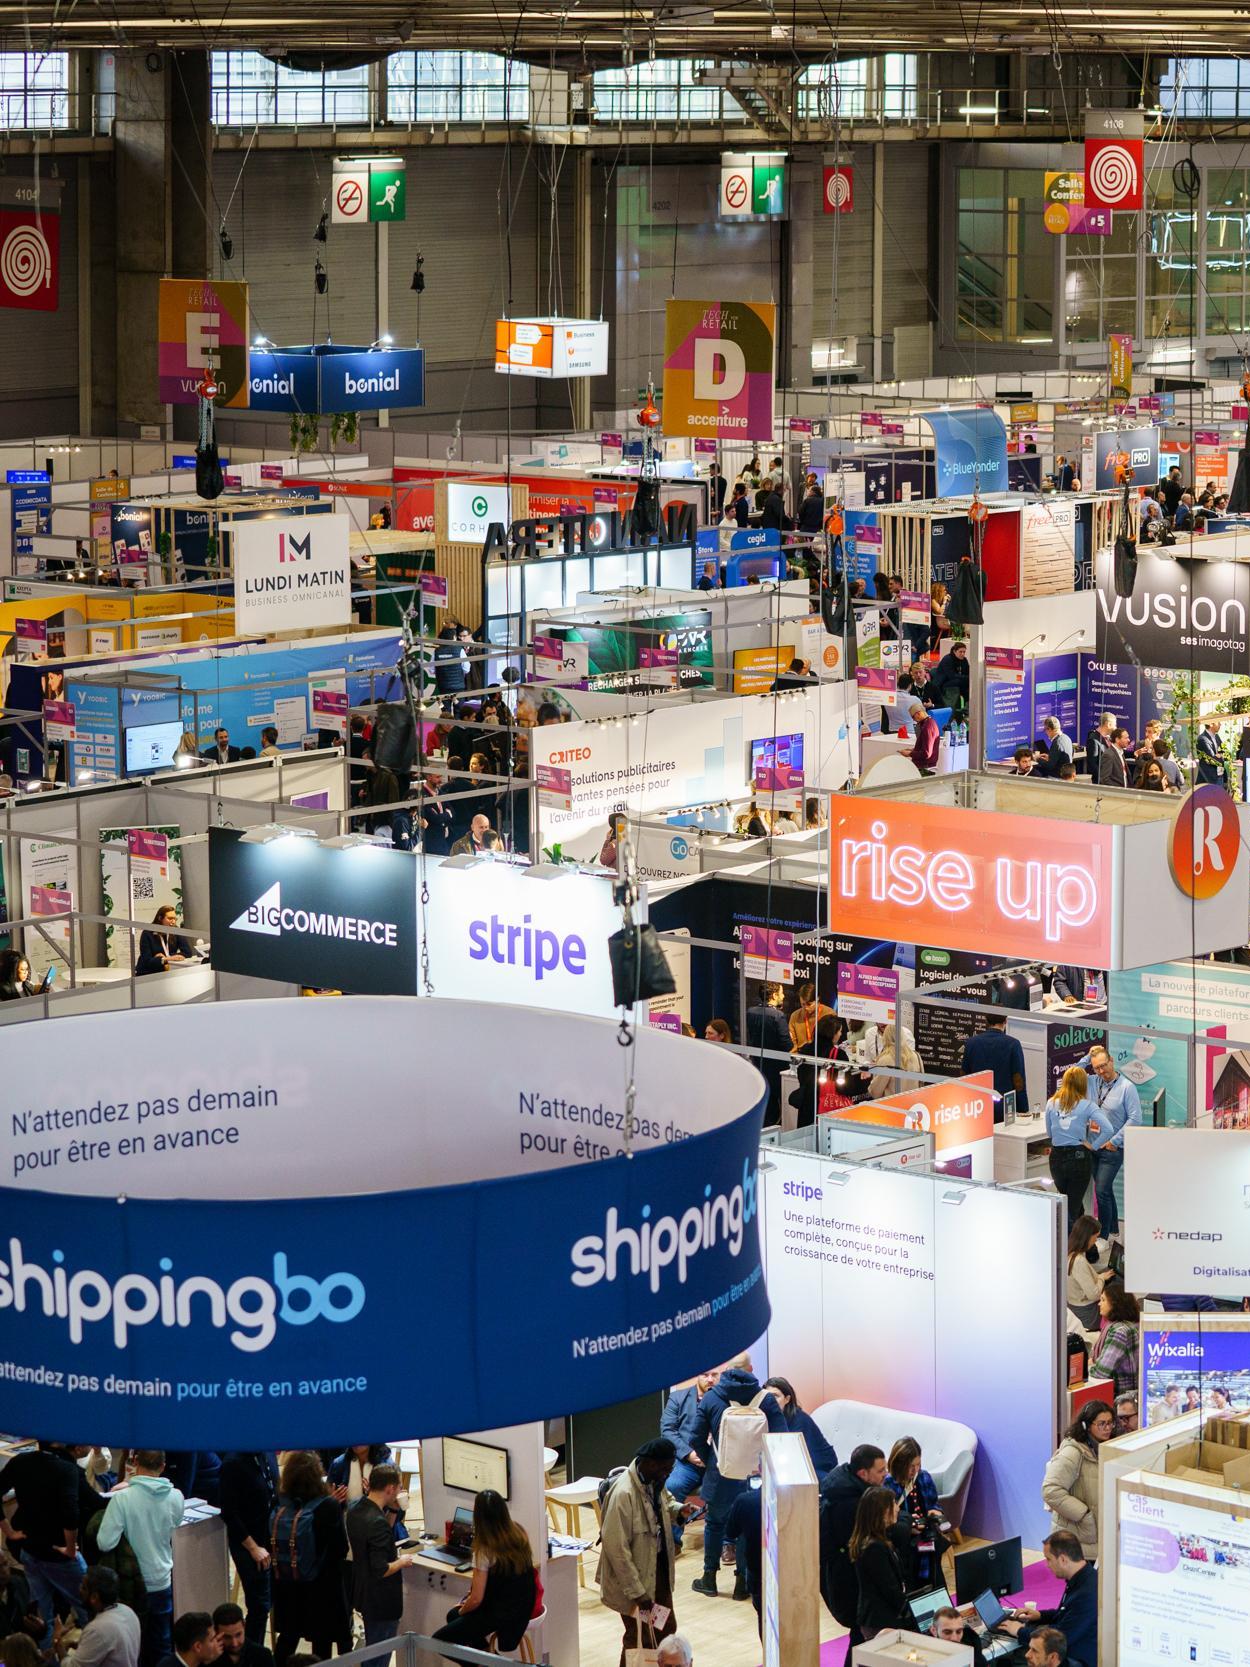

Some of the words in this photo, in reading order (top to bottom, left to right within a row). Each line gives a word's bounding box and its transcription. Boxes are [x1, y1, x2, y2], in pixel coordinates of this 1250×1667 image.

[1090, 215, 1105, 227] #5
[702, 319, 738, 331] RETAIL
[186, 312, 221, 369] E
[345, 367, 400, 395] bonial
[694, 338, 747, 401] D
[687, 413, 748, 429] accenture
[953, 460, 1000, 475] BlueYonder
[1133, 452, 1148, 463] PRO
[698, 546, 714, 555] Store
[748, 533, 766, 546] cegid
[245, 575, 292, 593] LUNDI
[298, 569, 345, 588] MATIN
[245, 594, 289, 607] BUSINESS
[292, 589, 345, 603] OMNICANAL
[1097, 584, 1247, 635] vusion
[1180, 636, 1198, 646] ses
[1198, 634, 1246, 653] imagotag
[549, 747, 591, 765] CRITEO
[571, 769, 615, 787] solutions
[617, 760, 676, 781] publicitaires
[606, 784, 646, 802] pensées
[648, 778, 671, 794] pour
[1193, 805, 1224, 876] R
[841, 820, 975, 912] rise
[996, 857, 1098, 942] up
[247, 904, 398, 947] BIGCOMMERCE
[468, 914, 587, 980] stripe
[920, 969, 948, 982] Logiciel
[1149, 977, 1161, 988] La
[1163, 978, 1206, 994] nouvelle
[1166, 1003, 1212, 1019] parcours
[1215, 1008, 1249, 1021] clients
[12, 1101, 130, 1136] N’attendez
[137, 1096, 179, 1124] pas
[187, 1085, 279, 1112] demain
[934, 1104, 962, 1126] rise
[965, 1098, 984, 1123] up
[13, 1145, 61, 1176] pour
[68, 1140, 111, 1163] être
[118, 1136, 145, 1155] en
[153, 1127, 240, 1151] avance
[783, 1180, 823, 1202] stripe
[784, 1211, 804, 1224] Une
[806, 1212, 861, 1236] plateforme
[863, 1222, 877, 1235] de
[878, 1225, 925, 1246] paiement
[1167, 1229, 1223, 1243] nedap
[784, 1227, 833, 1250] complète,
[835, 1237, 872, 1254] conçue
[873, 1243, 894, 1258] pour
[897, 1246, 909, 1259] la
[784, 1243, 838, 1266] croissance
[840, 1252, 854, 1266] de
[855, 1255, 881, 1270] votre
[882, 1258, 935, 1281] entreprise
[1147, 1342, 1205, 1358] Wixalia
[68, 1372, 99, 1393] pas
[104, 1373, 171, 1397] demain
[177, 1381, 221, 1401] pour
[226, 1377, 263, 1396] être
[268, 1381, 292, 1396] en
[299, 1374, 368, 1396] avance
[1127, 1492, 1148, 1505] Cas
[1132, 1503, 1165, 1519] client
